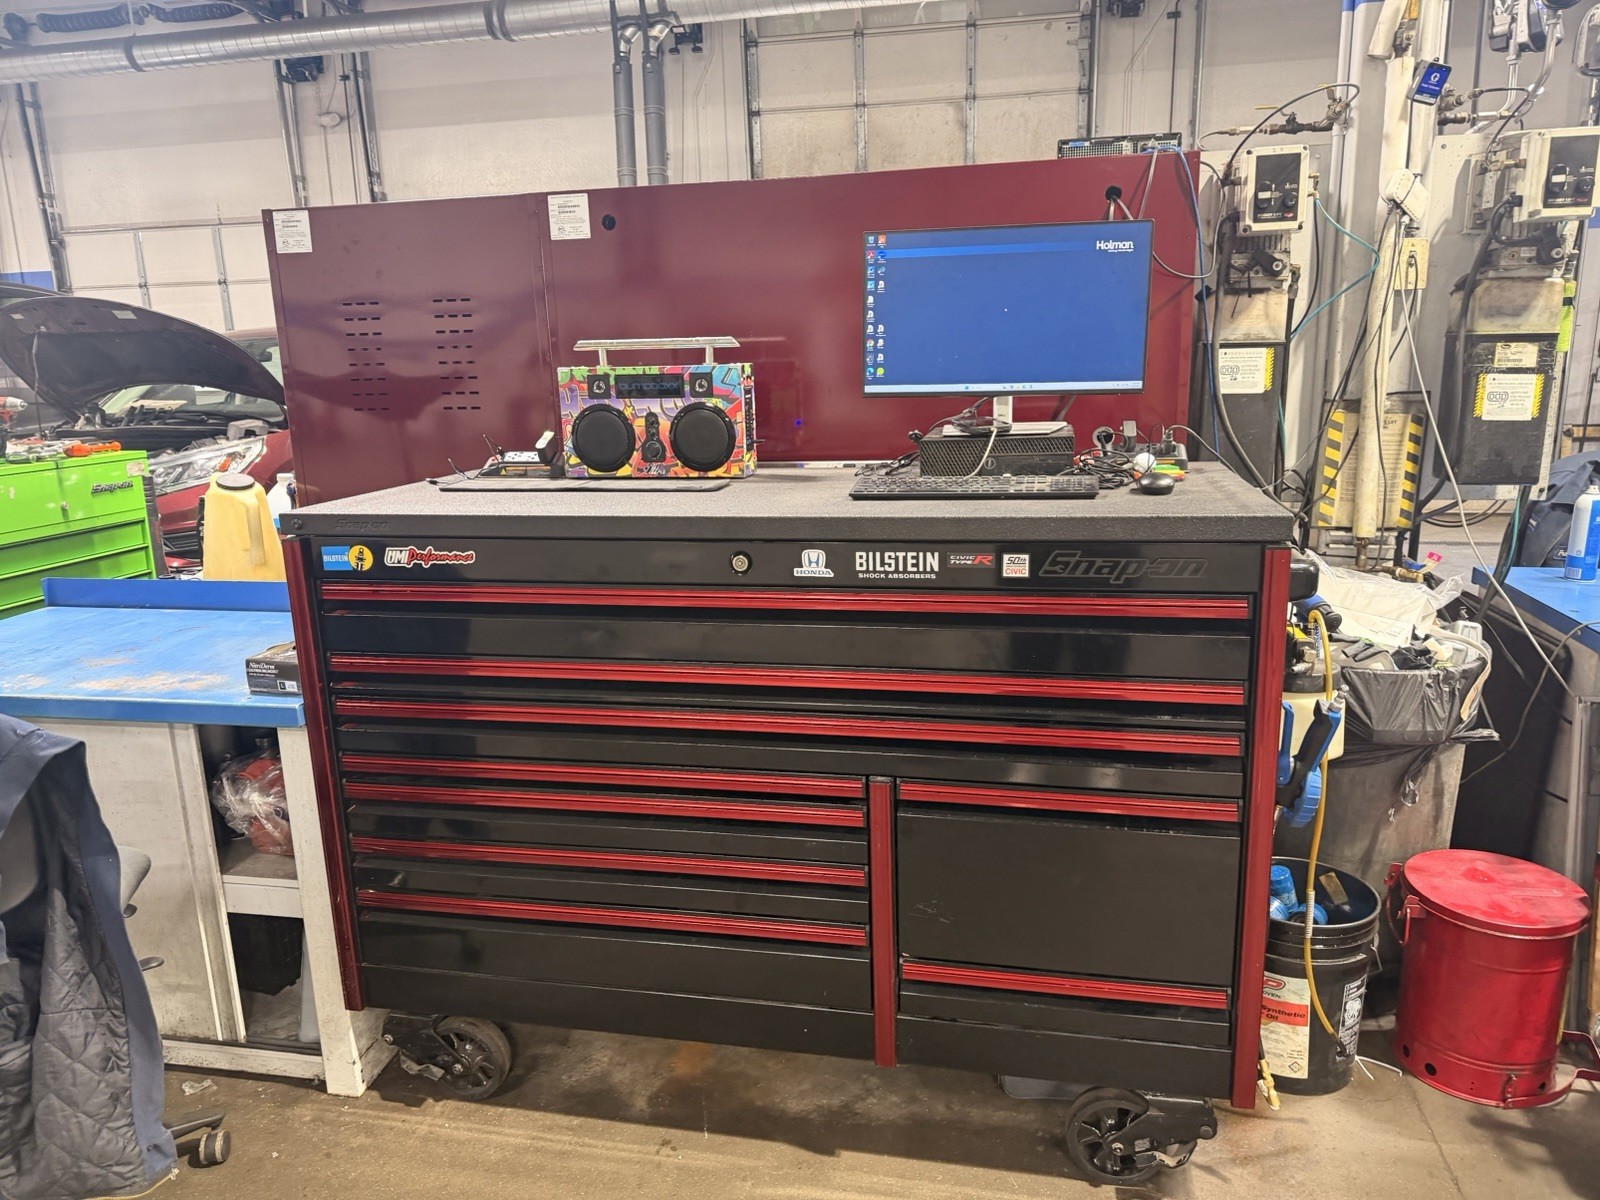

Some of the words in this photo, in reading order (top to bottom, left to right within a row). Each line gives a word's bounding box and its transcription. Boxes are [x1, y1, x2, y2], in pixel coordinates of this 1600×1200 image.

[1096, 240, 1134, 250] Holman
[323, 554, 349, 562] BILSTEIN
[407, 548, 474, 566] Performance
[855, 551, 940, 572] BILSTEIN
[972, 554, 993, 565] R
[1006, 556, 1026, 565] 50th
[1038, 550, 1208, 584] Snap-on
[1261, 1005, 1306, 1019] Synthetic
[1266, 1013, 1279, 1021] Oil
